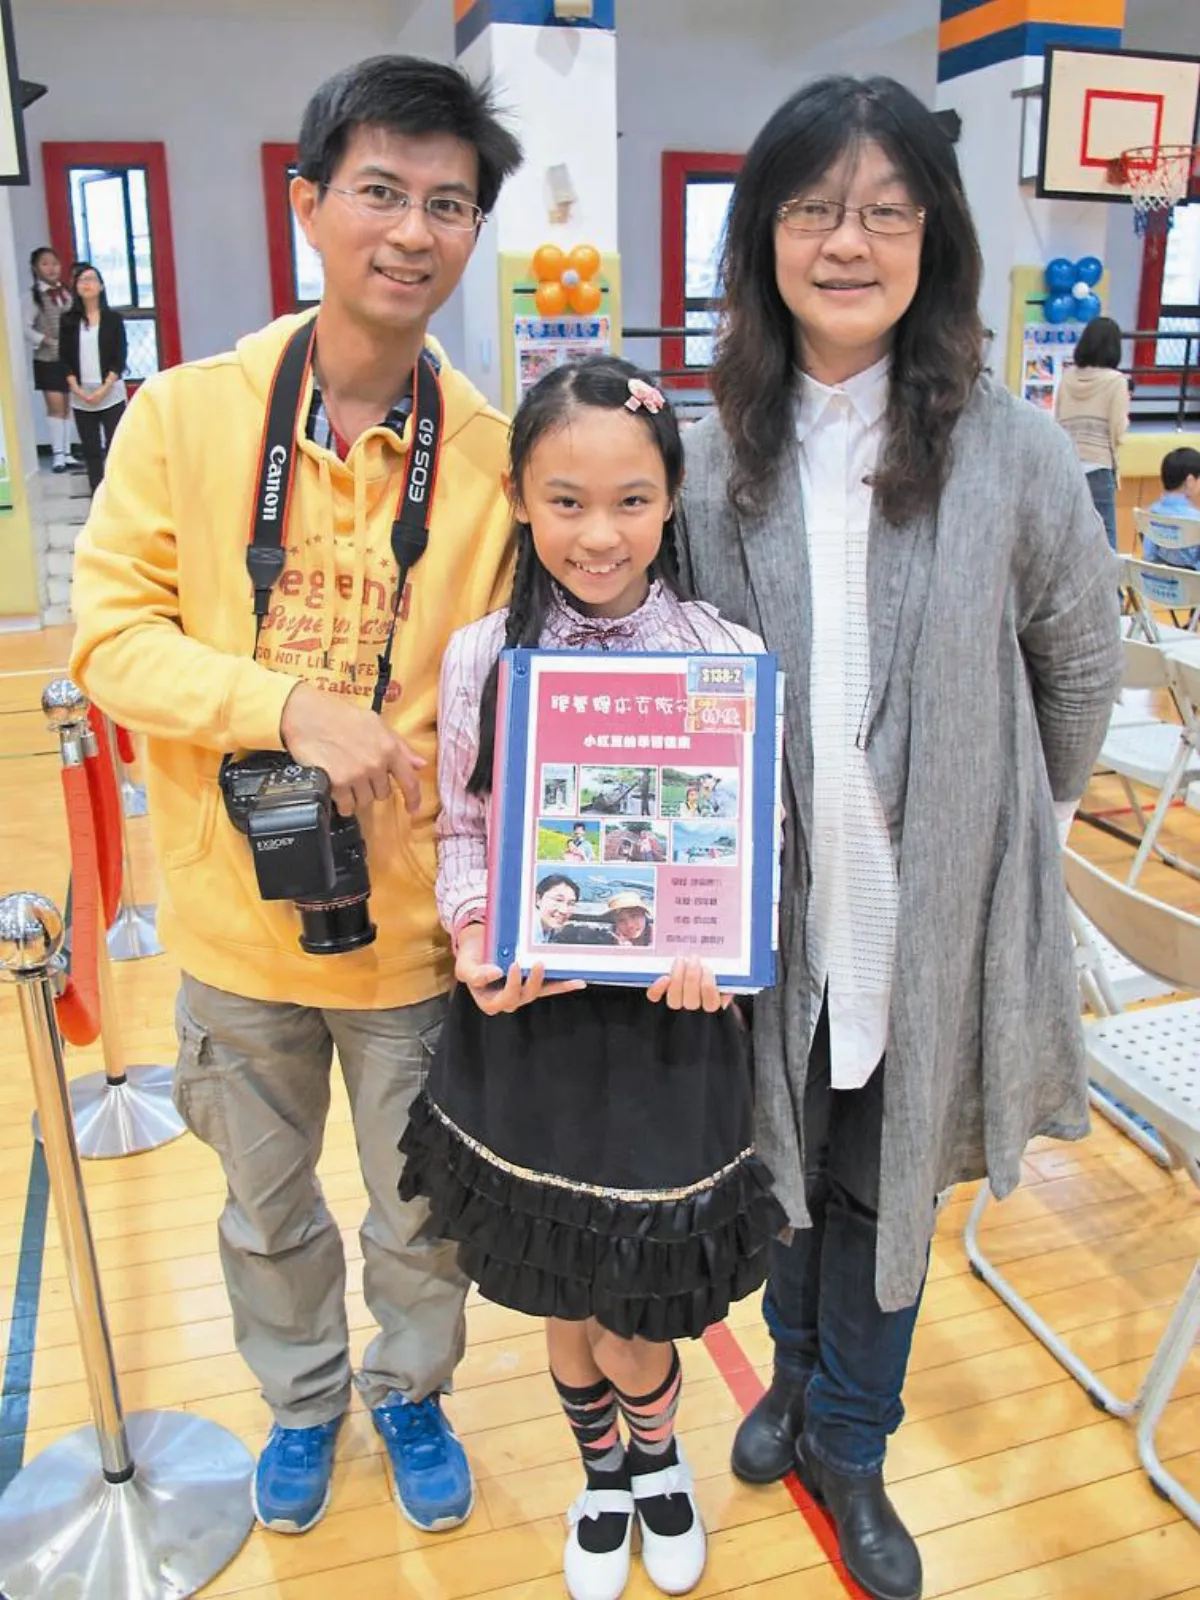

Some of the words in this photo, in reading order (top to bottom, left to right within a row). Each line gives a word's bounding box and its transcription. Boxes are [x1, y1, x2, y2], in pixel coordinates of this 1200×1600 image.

[263, 444, 287, 520] Canon
[408, 450, 430, 502] EOS
[419, 418, 434, 446] 6D
[251, 570, 412, 621] egend
[275, 650, 301, 665] NOT
[316, 676, 373, 697] Taker
